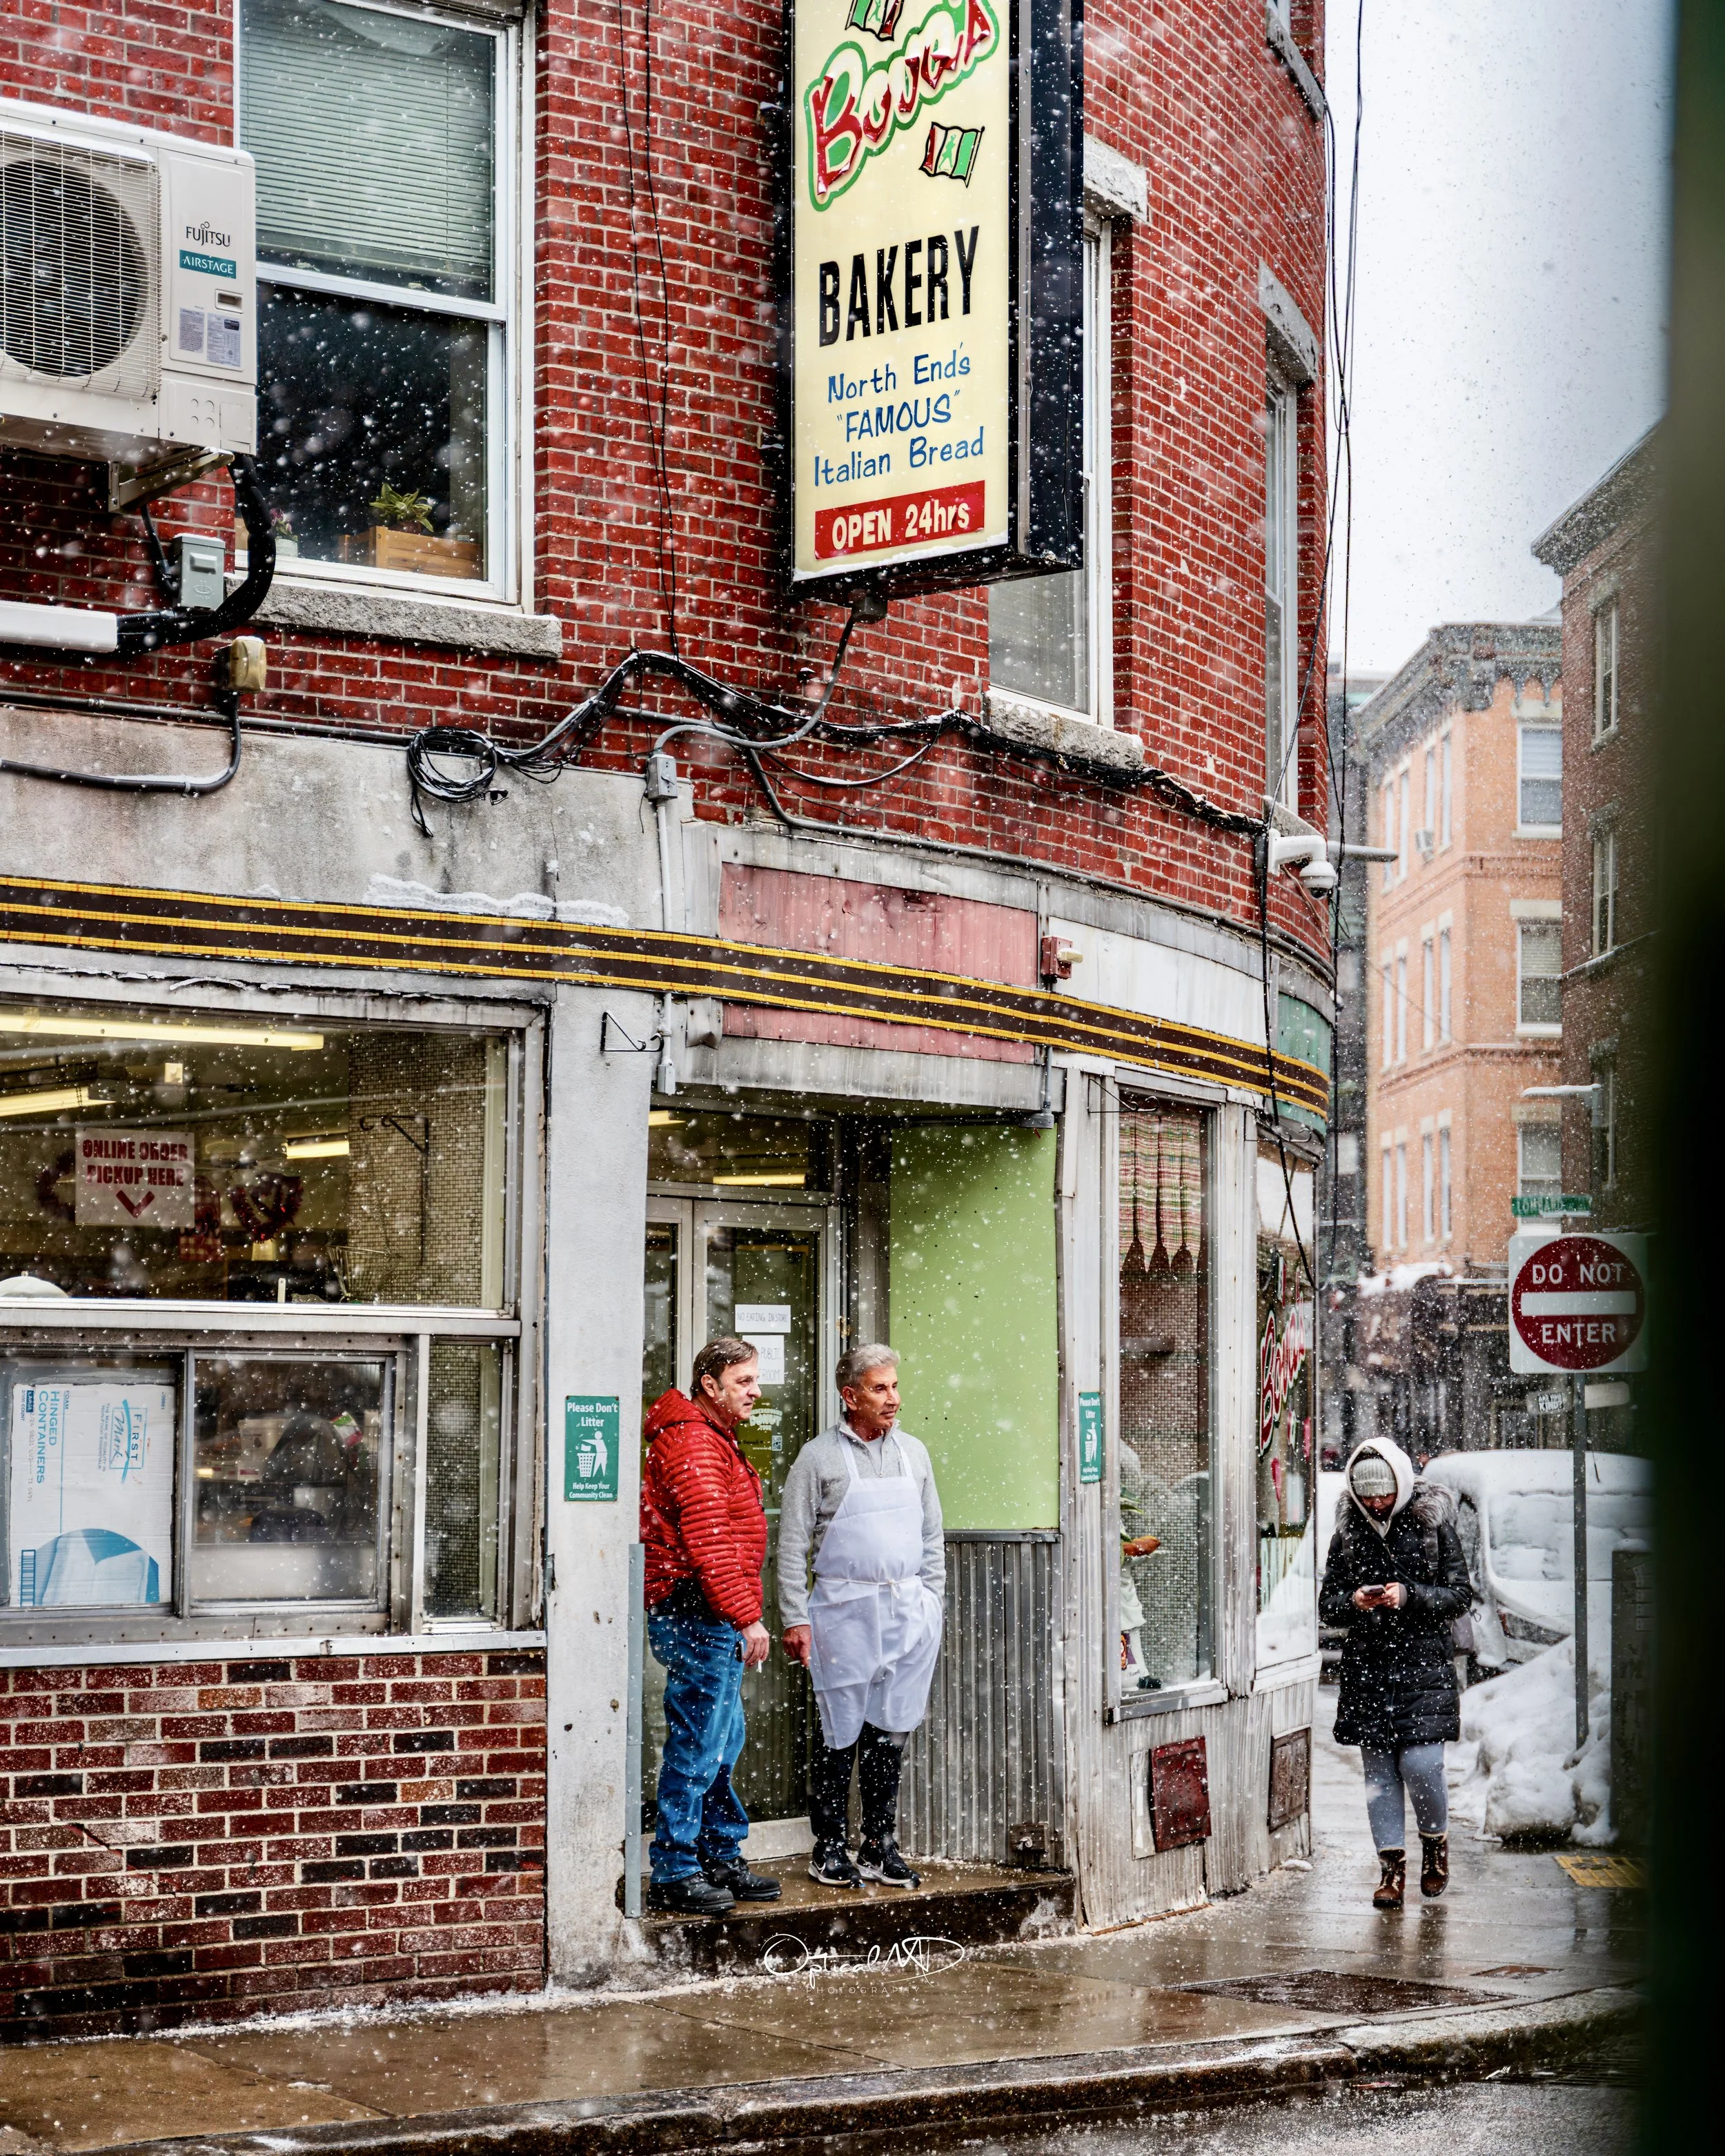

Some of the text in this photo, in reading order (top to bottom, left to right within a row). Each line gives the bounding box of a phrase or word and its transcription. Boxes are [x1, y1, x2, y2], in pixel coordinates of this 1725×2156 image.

[186, 221, 230, 247] FUJITSU
[182, 255, 234, 274] AIRSTAGE
[819, 225, 980, 346] BAKERY
[827, 342, 972, 404] North End's
[837, 389, 960, 443] "FAMOUS"
[814, 426, 985, 487] Italian Bread
[831, 499, 970, 551] OPEN 24hrs
[82, 1138, 188, 1161] ONLINE ORDER
[86, 1165, 184, 1187] PICKUP HERE
[1532, 1263, 1624, 1285] DO NOT
[737, 1312, 745, 1321] NO
[746, 1313, 766, 1322] EATING
[1542, 1323, 1617, 1343] ENTER
[566, 1402, 618, 1413] Please Don't
[580, 1416, 604, 1427] Litter
[37, 1391, 49, 1484] CONTAINERS
[573, 1482, 584, 1490] Help
